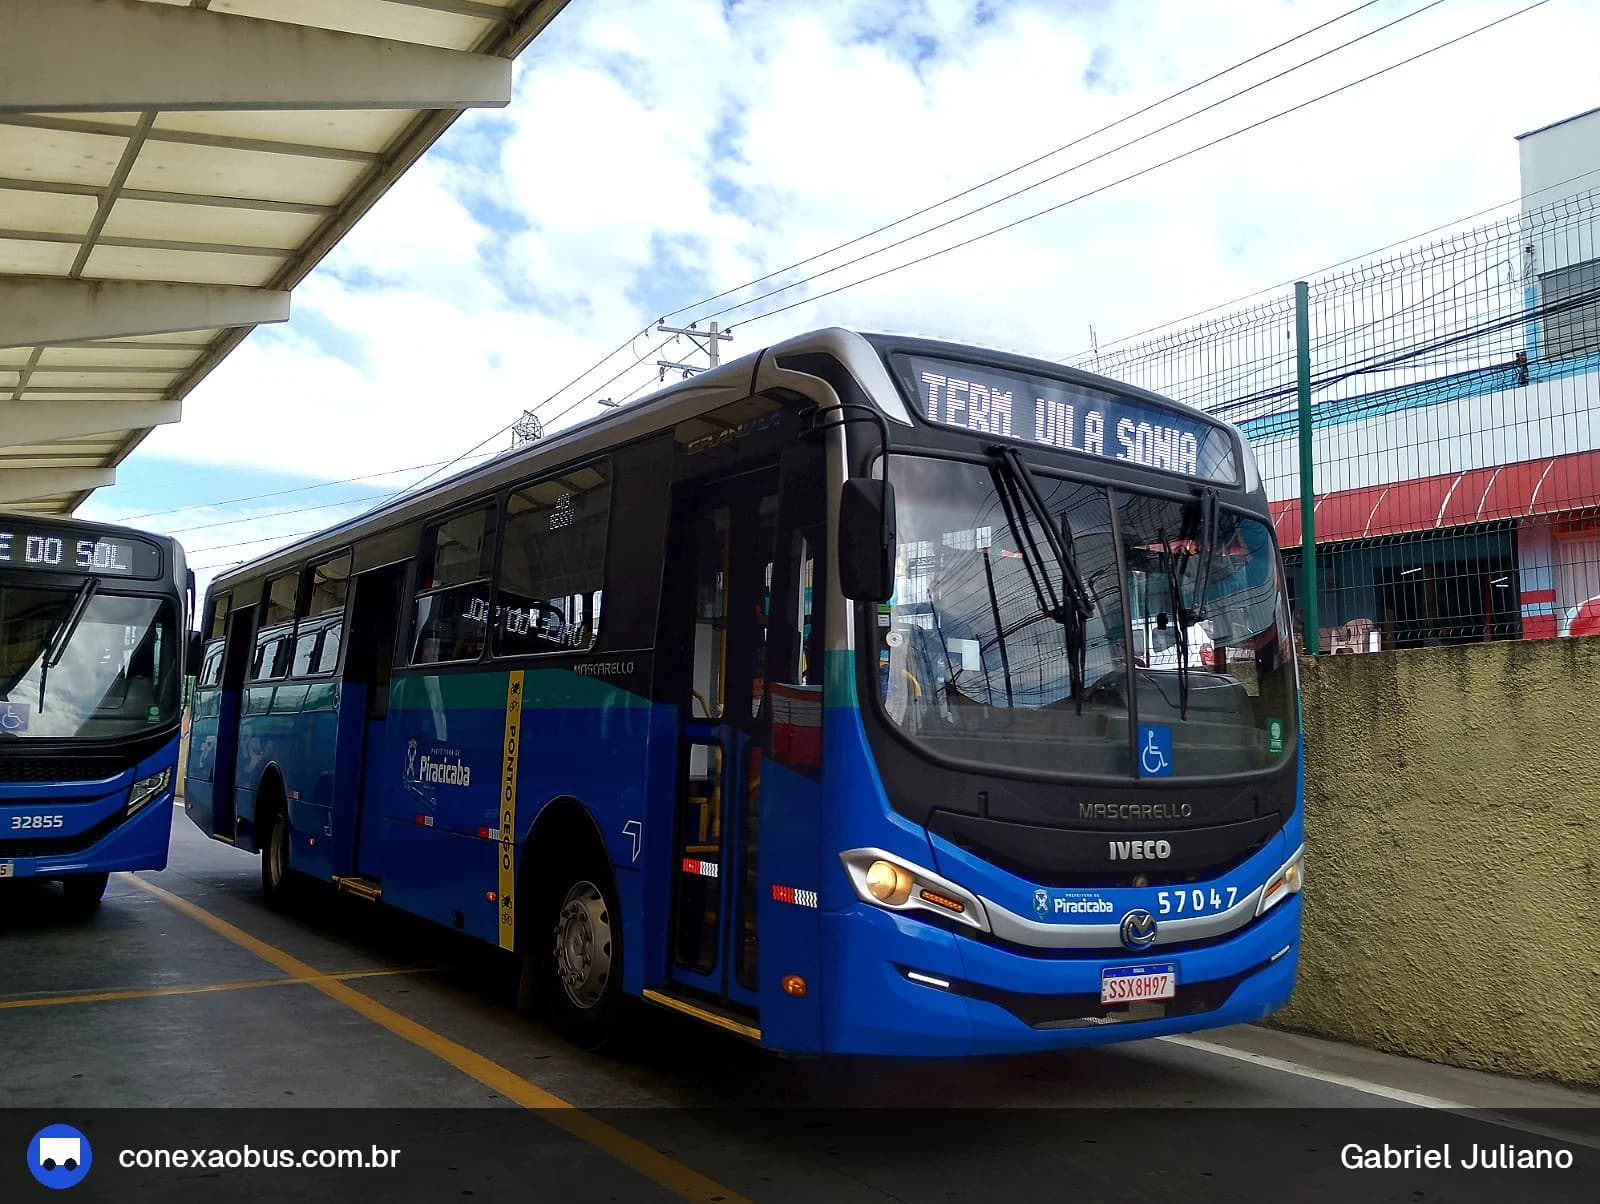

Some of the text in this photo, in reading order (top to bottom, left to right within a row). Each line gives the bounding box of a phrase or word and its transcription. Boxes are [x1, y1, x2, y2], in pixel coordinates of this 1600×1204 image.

[1035, 398, 1104, 455] VILA
[1116, 418, 1198, 476] SONIA
[25, 535, 63, 565] DO
[76, 540, 128, 569] SOL
[573, 661, 634, 676] MASCARELLO
[420, 756, 471, 787] Piracicaba
[502, 725, 517, 871] PONTO CEGO
[11, 815, 64, 830] 32855
[1079, 803, 1191, 819] MASCARELLO
[1109, 840, 1171, 860] IVECO
[1054, 898, 1114, 913] Piracicaba
[1157, 887, 1238, 914] 57047
[1109, 975, 1168, 998] SSX8H97
